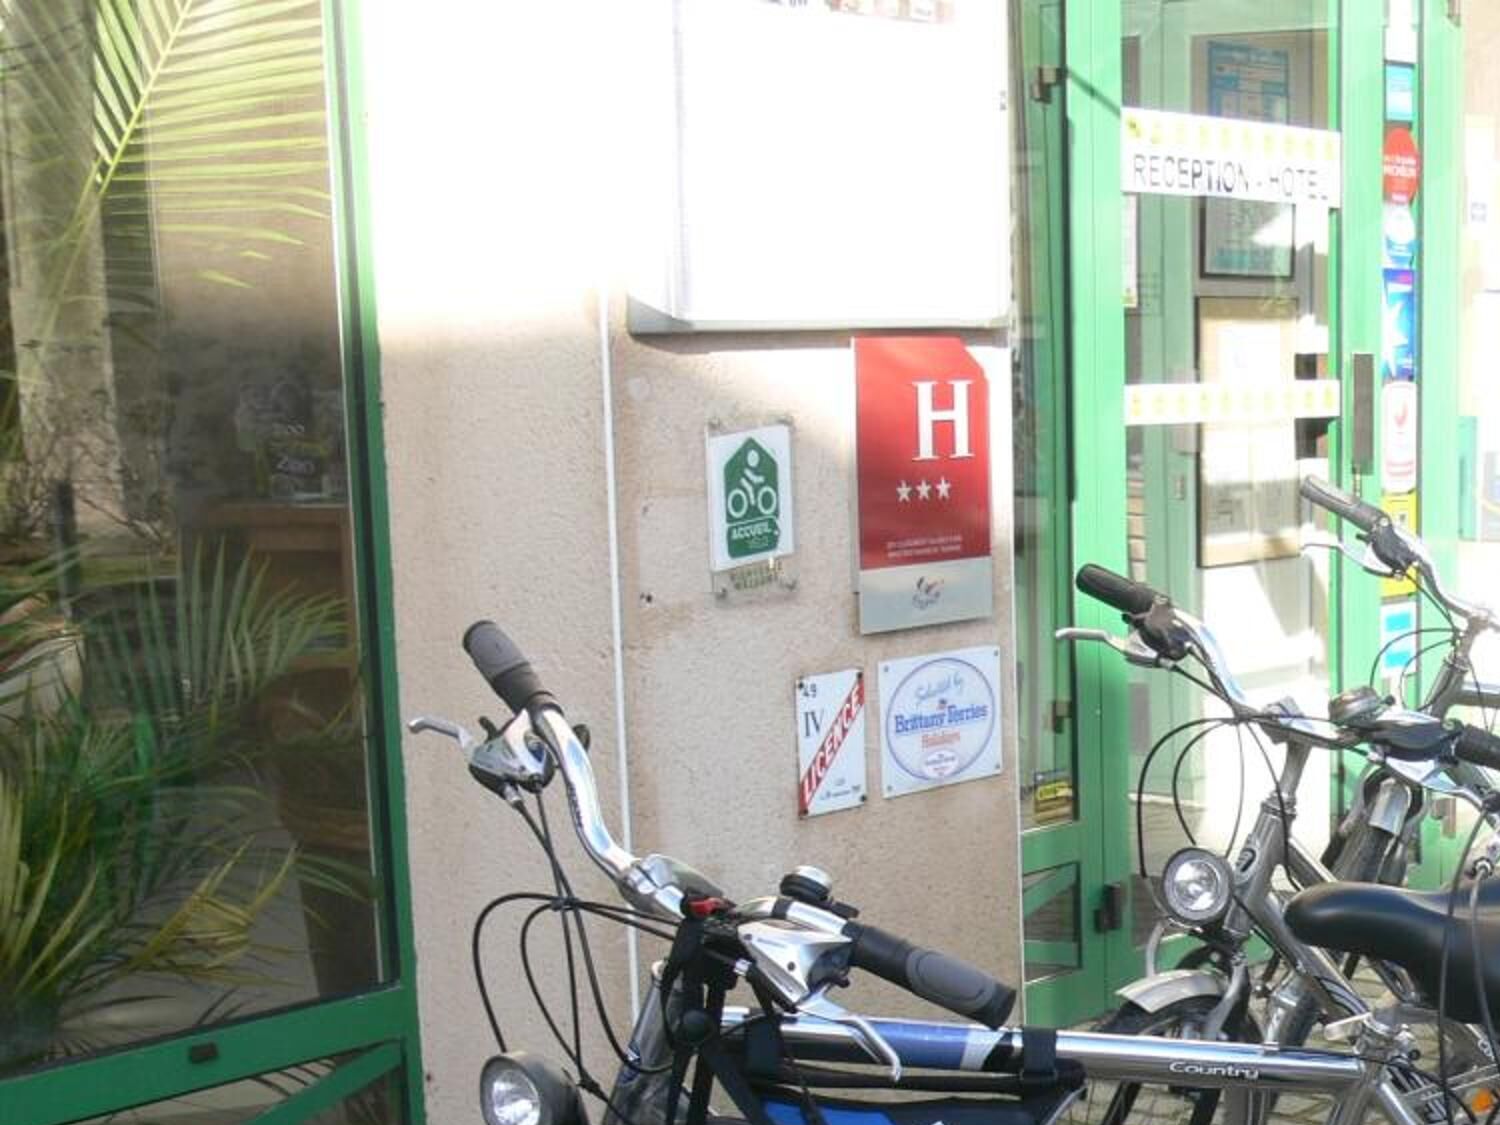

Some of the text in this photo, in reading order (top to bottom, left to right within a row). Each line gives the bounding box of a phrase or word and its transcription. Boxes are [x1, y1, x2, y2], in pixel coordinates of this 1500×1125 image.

[1133, 154, 1249, 193] RECEPTION
[911, 378, 976, 462] H
[731, 521, 772, 540] ACCUEIL
[894, 703, 989, 734] Brittany Ferries
[803, 681, 863, 803] LICENCE
[1169, 1061, 1259, 1080] Country
